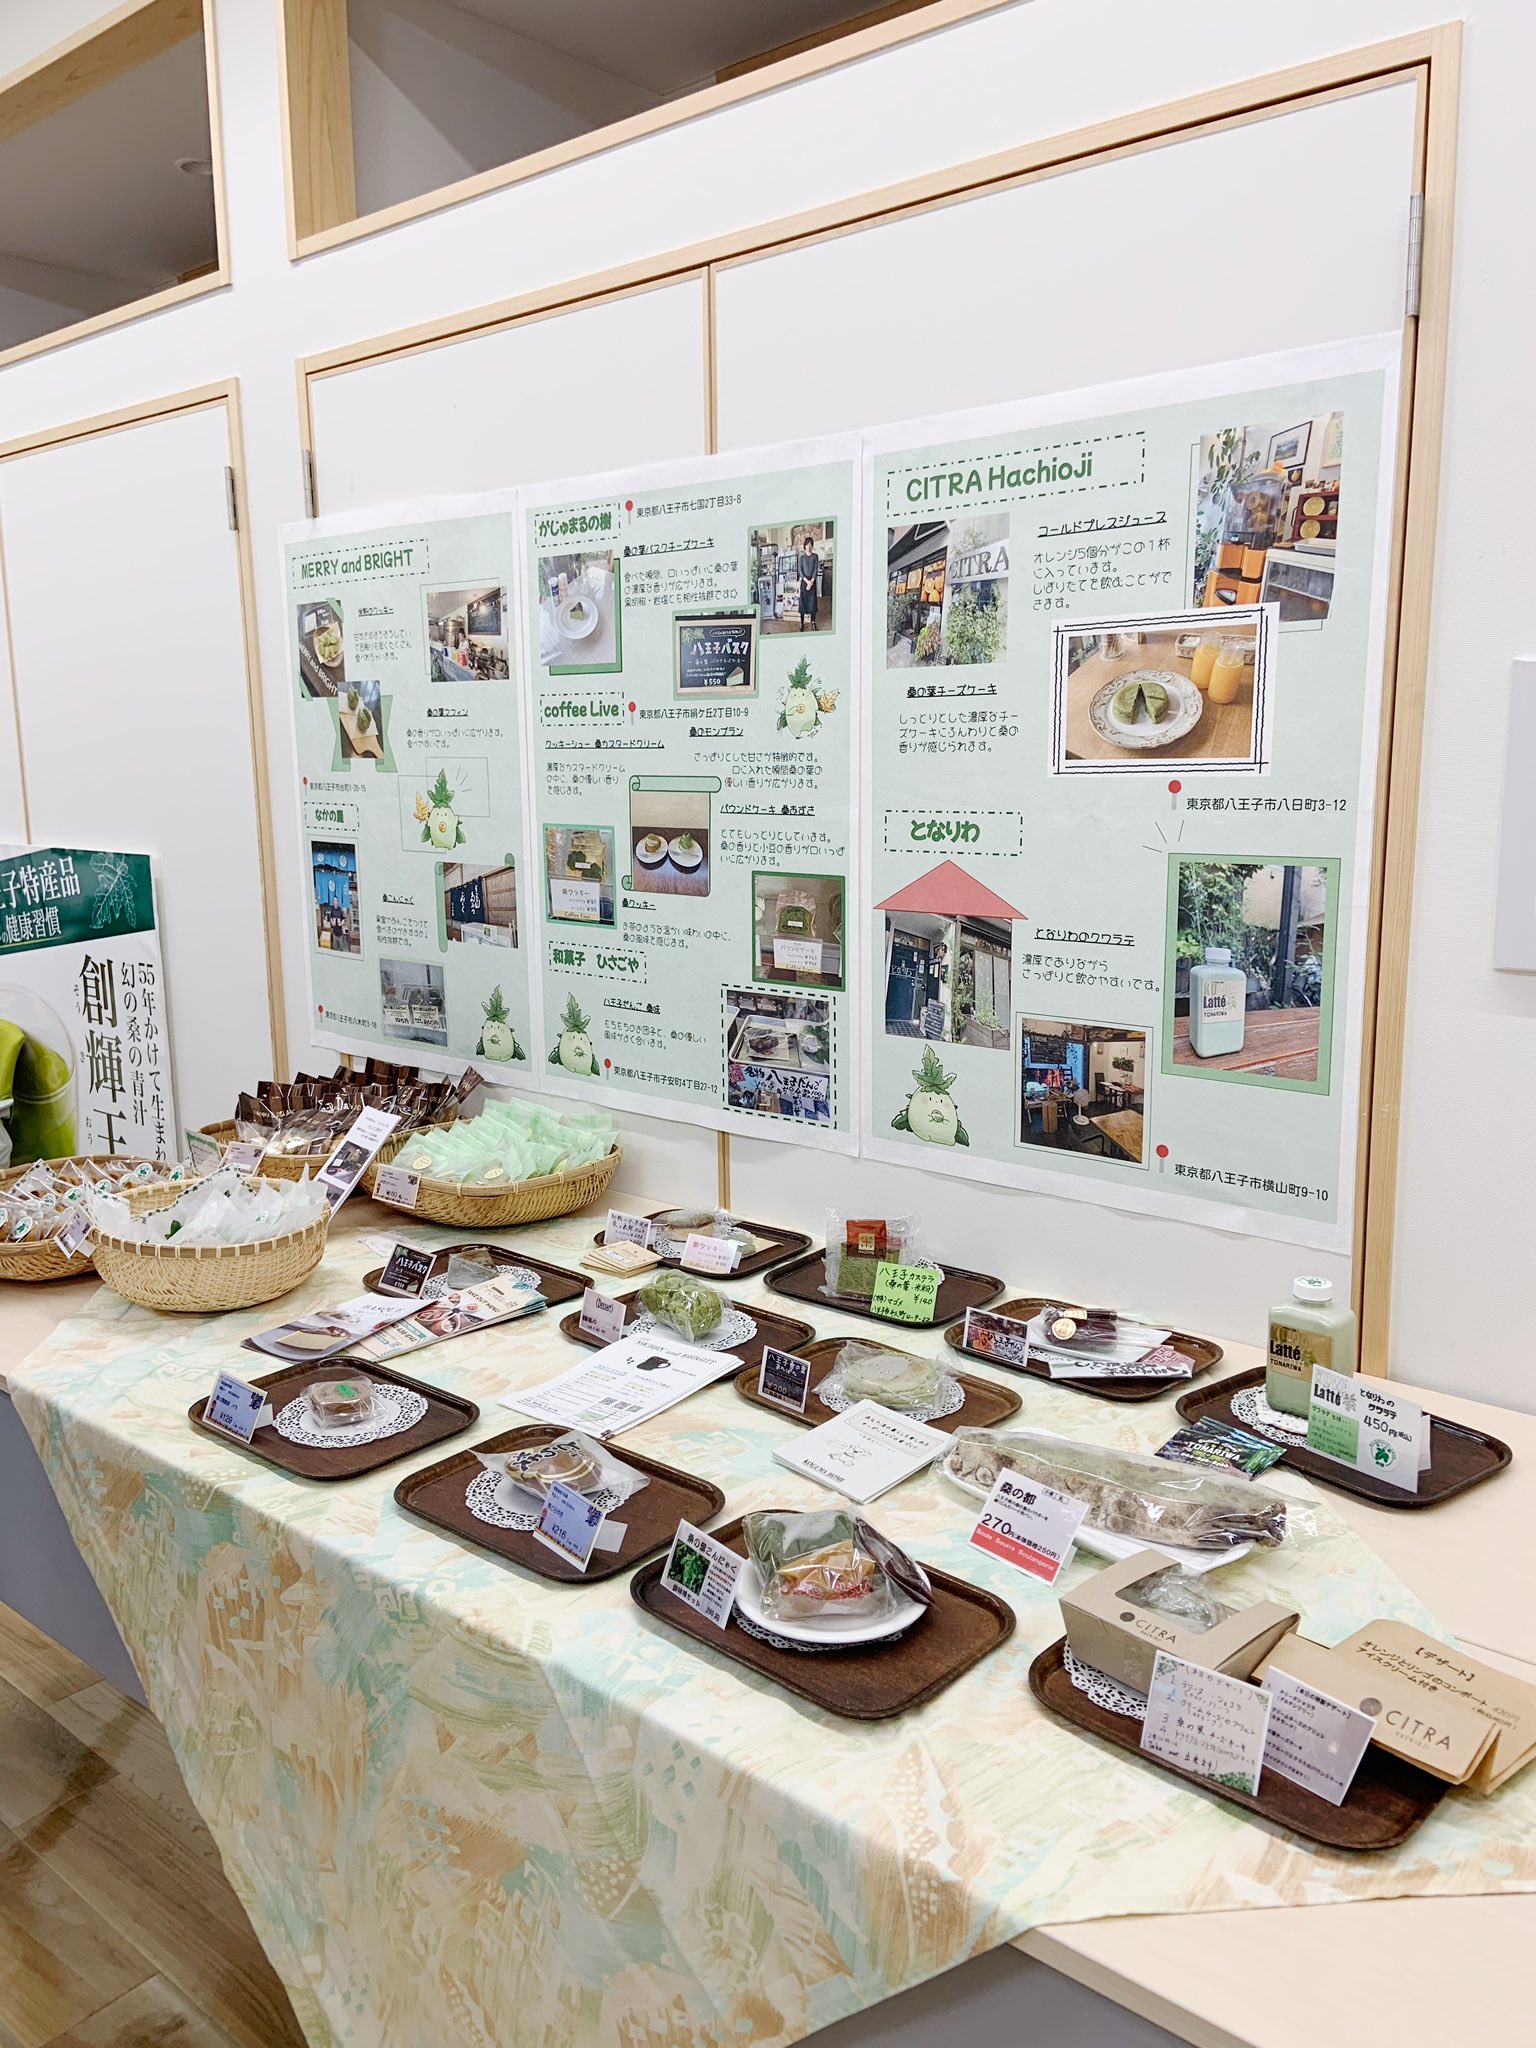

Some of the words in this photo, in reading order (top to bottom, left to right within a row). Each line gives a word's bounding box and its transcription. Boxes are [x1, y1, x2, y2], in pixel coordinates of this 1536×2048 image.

[906, 468, 983, 502] CITRA
[988, 451, 1093, 492] Hachioji
[636, 495, 742, 518] 東京都八王子市七国2丁目33-8
[539, 512, 612, 538] がじゅまるの樹
[1037, 511, 1168, 537] コールドプレスジュース
[624, 538, 715, 557] 桑の葉バスクチーズケーキ
[301, 559, 339, 580] MERRY
[341, 555, 362, 574] and
[364, 548, 413, 571] BRIGHT
[951, 545, 1009, 580] CITRA
[1033, 561, 1118, 580] に入っています。
[624, 577, 717, 595] の濃厚な香りが広がります。
[1032, 571, 1172, 595] しぼりたてを飲むことがで
[1032, 597, 1071, 611] きます。
[690, 638, 750, 656] 八王子バスク
[704, 678, 721, 686] ¥550
[907, 683, 998, 698] 桑の葉チーズケーキ
[427, 707, 468, 717] 桑の葉マフィン
[544, 701, 587, 719] coffee
[590, 700, 619, 717] Live
[899, 711, 1018, 725] しっとりとした濃厚なチー
[689, 726, 744, 738] 桑のモンブラン
[899, 725, 1020, 738] ズケーキにふんわりと桑の
[546, 740, 591, 749] クッキーシュー
[595, 739, 665, 749] 桑カスタードクリーム
[898, 741, 992, 754] 香りが感じられます。
[694, 751, 820, 763] さっぱりとした甘さが特徴的です。
[732, 764, 823, 776] 口に入れた瞬間桑の葉の
[724, 776, 819, 789] 優しい香りが広がります。
[720, 804, 776, 815] パウンドケーキ
[781, 804, 815, 816] 桑あずき
[1186, 797, 1348, 814] 東京都八王子市八日町3-12
[721, 828, 832, 843] とてもしっとりとしています。
[910, 819, 980, 844] となりわ
[720, 841, 846, 857] 桑の香りと小豆の香りが口いっぱ
[720, 854, 781, 867] いに広がります。
[0, 856, 80, 909] 子特産品
[622, 898, 656, 910] 桑クッキー
[623, 933, 689, 949] 桑の風味を感じます。
[1034, 928, 1135, 947] となりわのクワラテ
[553, 948, 586, 967] 和菓子
[597, 953, 640, 973] ひさごや
[1022, 953, 1109, 972] 濃厚でありながら
[1022, 968, 1160, 993] さっぱりと飲みやすいです。
[1203, 994, 1226, 1008] Latté
[120, 962, 148, 1127] 幻の桑の青汁
[614, 1066, 717, 1094] 東京都八王子市子安町4丁目27-12
[1174, 1162, 1330, 1202] 東京都八王子市横山町9-10
[878, 1267, 935, 1283] 八王子カステラ
[1270, 1339, 1301, 1361] Latté
[1270, 1358, 1302, 1372] TONARIWA
[766, 1380, 787, 1395] ¥200
[1314, 1383, 1341, 1406] Latté
[1360, 1389, 1395, 1408] となりわの
[1368, 1403, 1397, 1420] クワラテ
[1187, 1441, 1241, 1461] TONARIWA
[1000, 1481, 1037, 1506] 桑の都
[552, 1522, 567, 1540] ¥216
[687, 1533, 738, 1574] 桑の葉こんにゃく
[976, 1528, 993, 1541] Boule
[995, 1538, 1016, 1552] Beurre
[1018, 1549, 1055, 1571] Boulangerie
[1136, 1619, 1177, 1644] CITRA
[1356, 1646, 1439, 1693] アイスクリーム付き
[1362, 1639, 1488, 1706] オレンジとリンゴのコンポート
[1414, 1647, 1476, 1682] 【デザート】
[1385, 1709, 1452, 1751] CITRA
